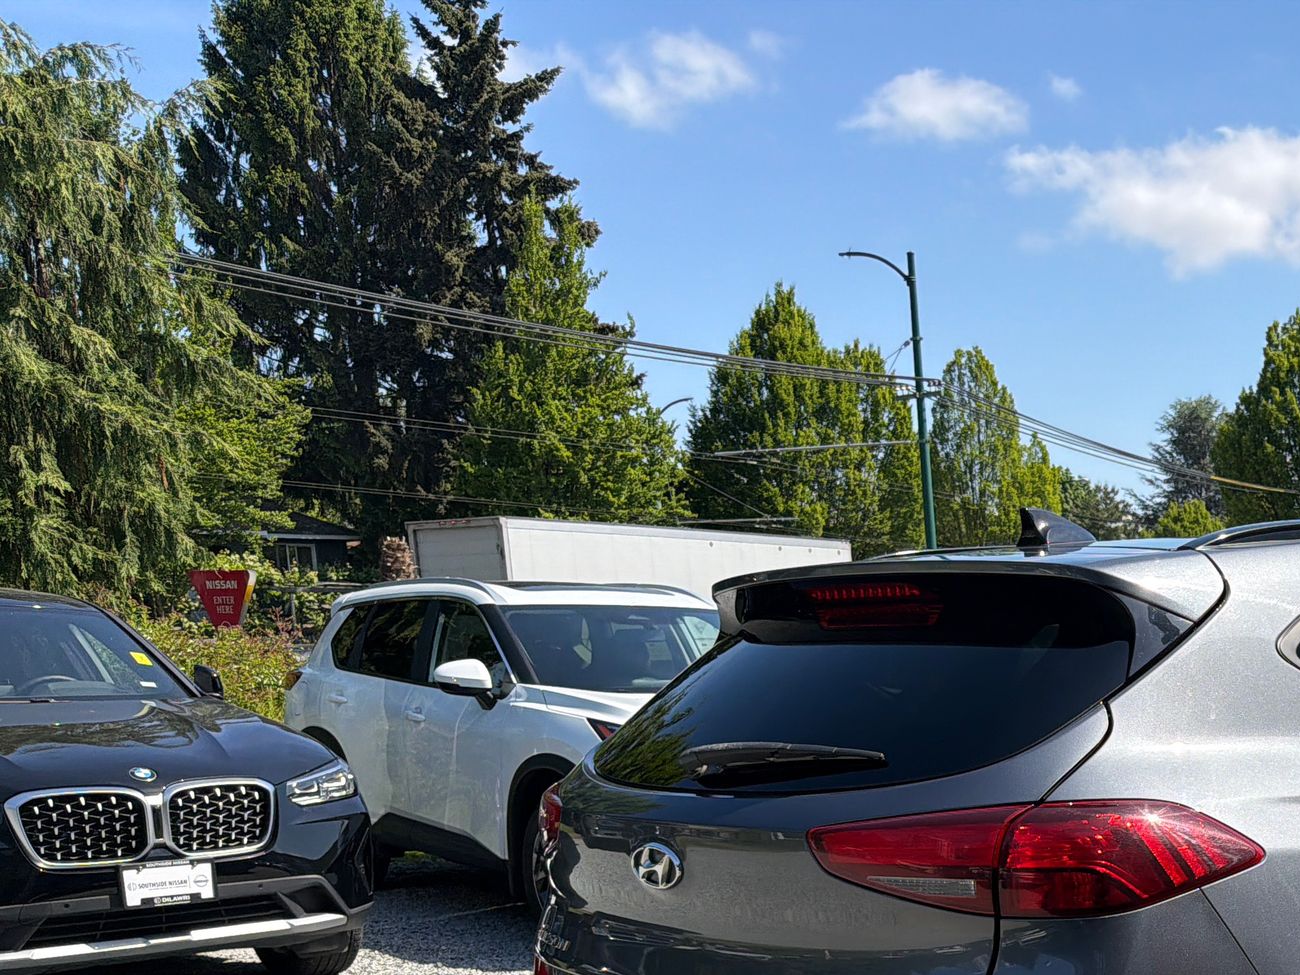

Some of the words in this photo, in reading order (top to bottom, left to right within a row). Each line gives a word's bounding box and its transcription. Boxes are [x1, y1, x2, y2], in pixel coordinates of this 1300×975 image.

[205, 580, 238, 590] NISSAN
[213, 596, 235, 605] ENTER
[216, 605, 234, 614] HERE
